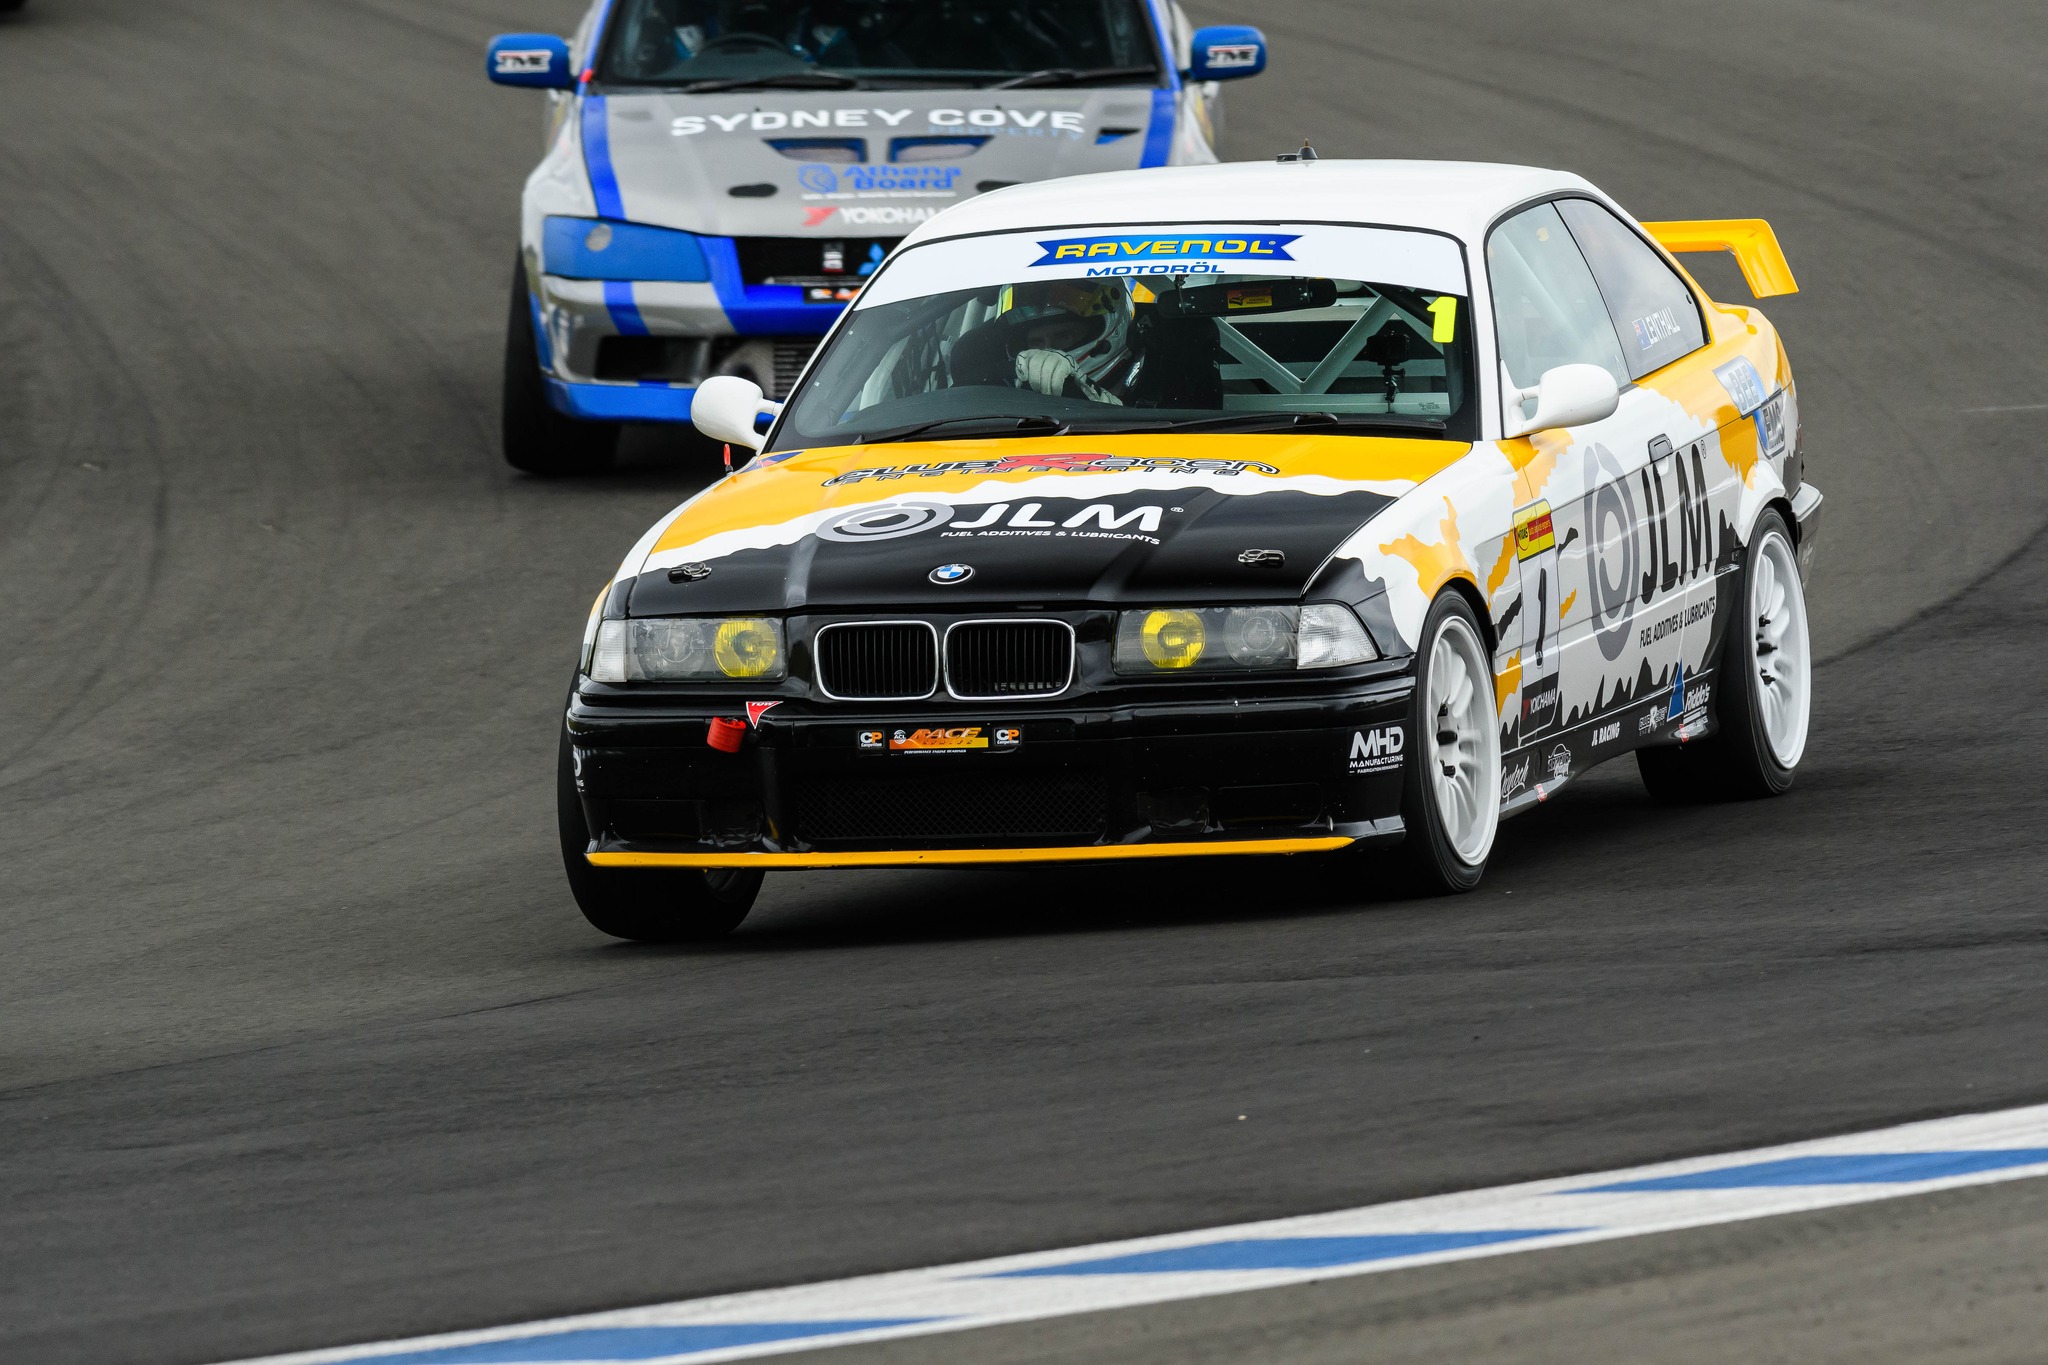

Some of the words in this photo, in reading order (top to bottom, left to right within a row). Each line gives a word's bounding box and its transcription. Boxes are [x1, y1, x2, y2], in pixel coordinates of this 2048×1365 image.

[671, 108, 914, 137] SYDNEY
[928, 108, 1086, 134] COVE
[843, 165, 962, 178] Athena
[854, 176, 954, 190] Board
[840, 206, 949, 224] YOKOHAM
[1086, 261, 1226, 276] MOTORÖL
[1427, 296, 1457, 343] 1
[1762, 400, 1785, 450] EMS
[948, 503, 1164, 532] JLM
[1640, 443, 1714, 605] JLM
[1071, 531, 1161, 545] LUBRICANTS
[1640, 626, 1652, 649] FUEL
[1652, 613, 1679, 643] ADDITIVES
[1678, 611, 1683, 630] &
[1684, 595, 1716, 628] LUBRICANTS
[1530, 687, 1556, 715] YOKOHAMA
[860, 731, 883, 744] CP
[910, 727, 982, 740] RACE
[996, 729, 1020, 743] CP
[1349, 725, 1405, 759] MHD
[1599, 721, 1620, 744] RACING
[1349, 754, 1404, 768] MANUFACTURING
